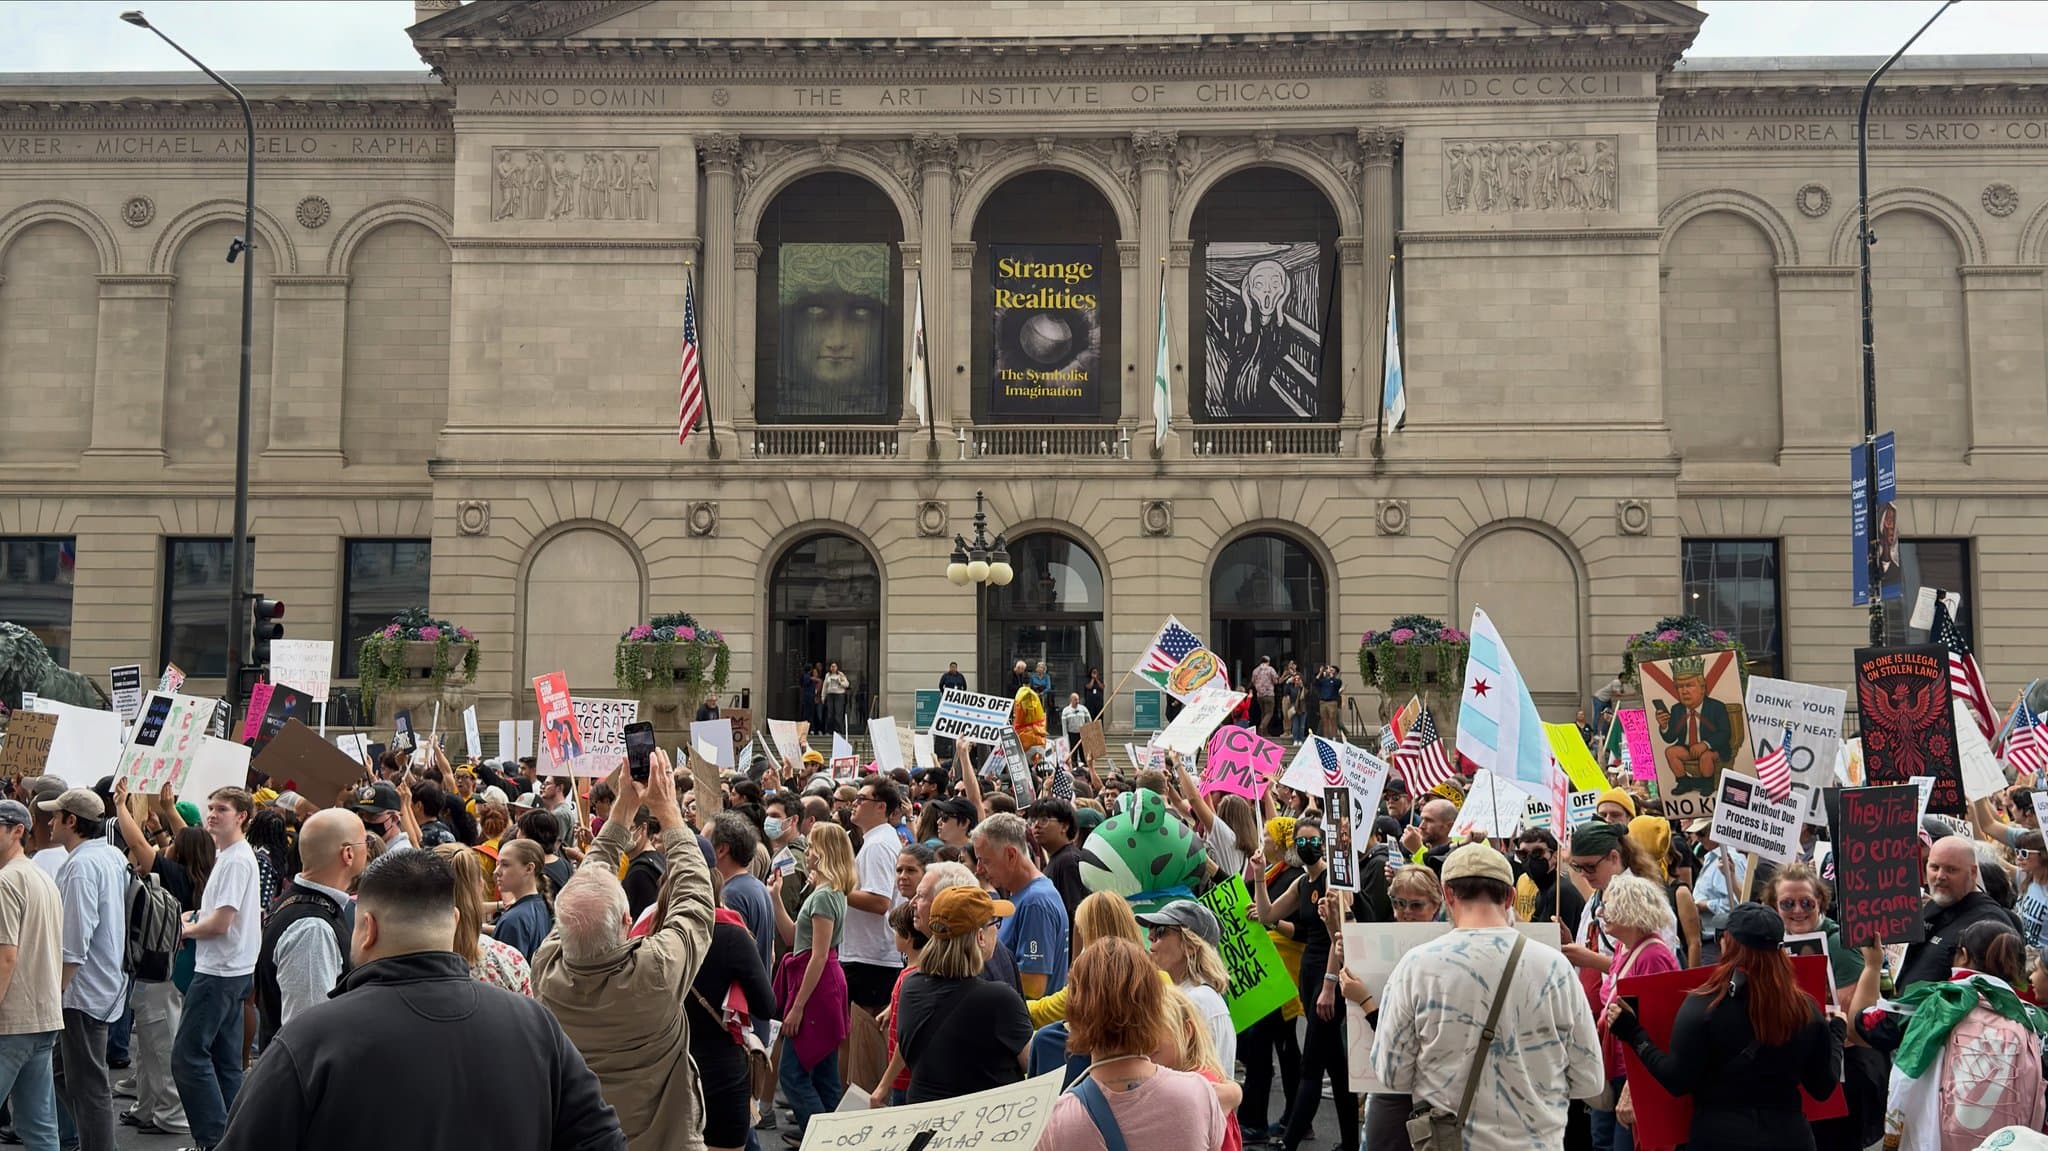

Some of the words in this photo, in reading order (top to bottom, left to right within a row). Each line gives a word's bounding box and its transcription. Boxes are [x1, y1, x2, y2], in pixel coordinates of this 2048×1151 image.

[491, 87, 560, 106] ANNO
[572, 87, 666, 106] DOMINI
[793, 87, 842, 106] THE
[880, 87, 928, 105] ART
[961, 86, 1100, 105] INSTITVTE
[1131, 85, 1166, 103] OF
[1196, 82, 1311, 102] CHICAGO
[1746, 123, 1838, 142] ANDREA
[1904, 122, 1980, 140] SARTO
[95, 137, 203, 154] MICHAEL
[998, 257, 1093, 284] Strange
[994, 287, 1097, 309] Realities
[1000, 368, 1023, 380] The
[1026, 368, 1088, 384] Symbolist
[1005, 384, 1083, 399] Imagination
[1862, 660, 1875, 672] NO
[1875, 654, 1893, 667] ONE
[1894, 654, 1903, 663] IS
[1904, 653, 1938, 669] ILLEGAL
[1867, 670, 1879, 681] ON
[1880, 664, 1913, 677] STOLEN
[1914, 665, 1939, 679] LAND
[944, 690, 985, 708] HANDS
[988, 698, 1011, 712] OFF
[1755, 693, 1792, 709] DRINK
[1802, 701, 1836, 716] YOUR
[935, 717, 1000, 741] CHICAGO
[1748, 713, 1800, 731] WHISKEY
[1345, 746, 1358, 760] Due
[1358, 753, 1382, 772] Process
[1345, 758, 1351, 768] is
[1356, 763, 1377, 779] RIGHT
[1343, 775, 1369, 797] Privilege
[1350, 770, 1361, 781] not
[1572, 792, 1596, 808] OFF
[1665, 800, 1693, 817] NO
[1726, 809, 1759, 829] Process
[1761, 819, 1769, 831] is
[1769, 822, 1785, 838] just
[1751, 802, 1781, 819] without
[1781, 813, 1795, 825] Due
[1842, 793, 1885, 834] They
[1715, 824, 1742, 841] called
[1870, 834, 1921, 862] erase
[1845, 894, 1919, 922] became
[1848, 914, 1912, 948] louder
